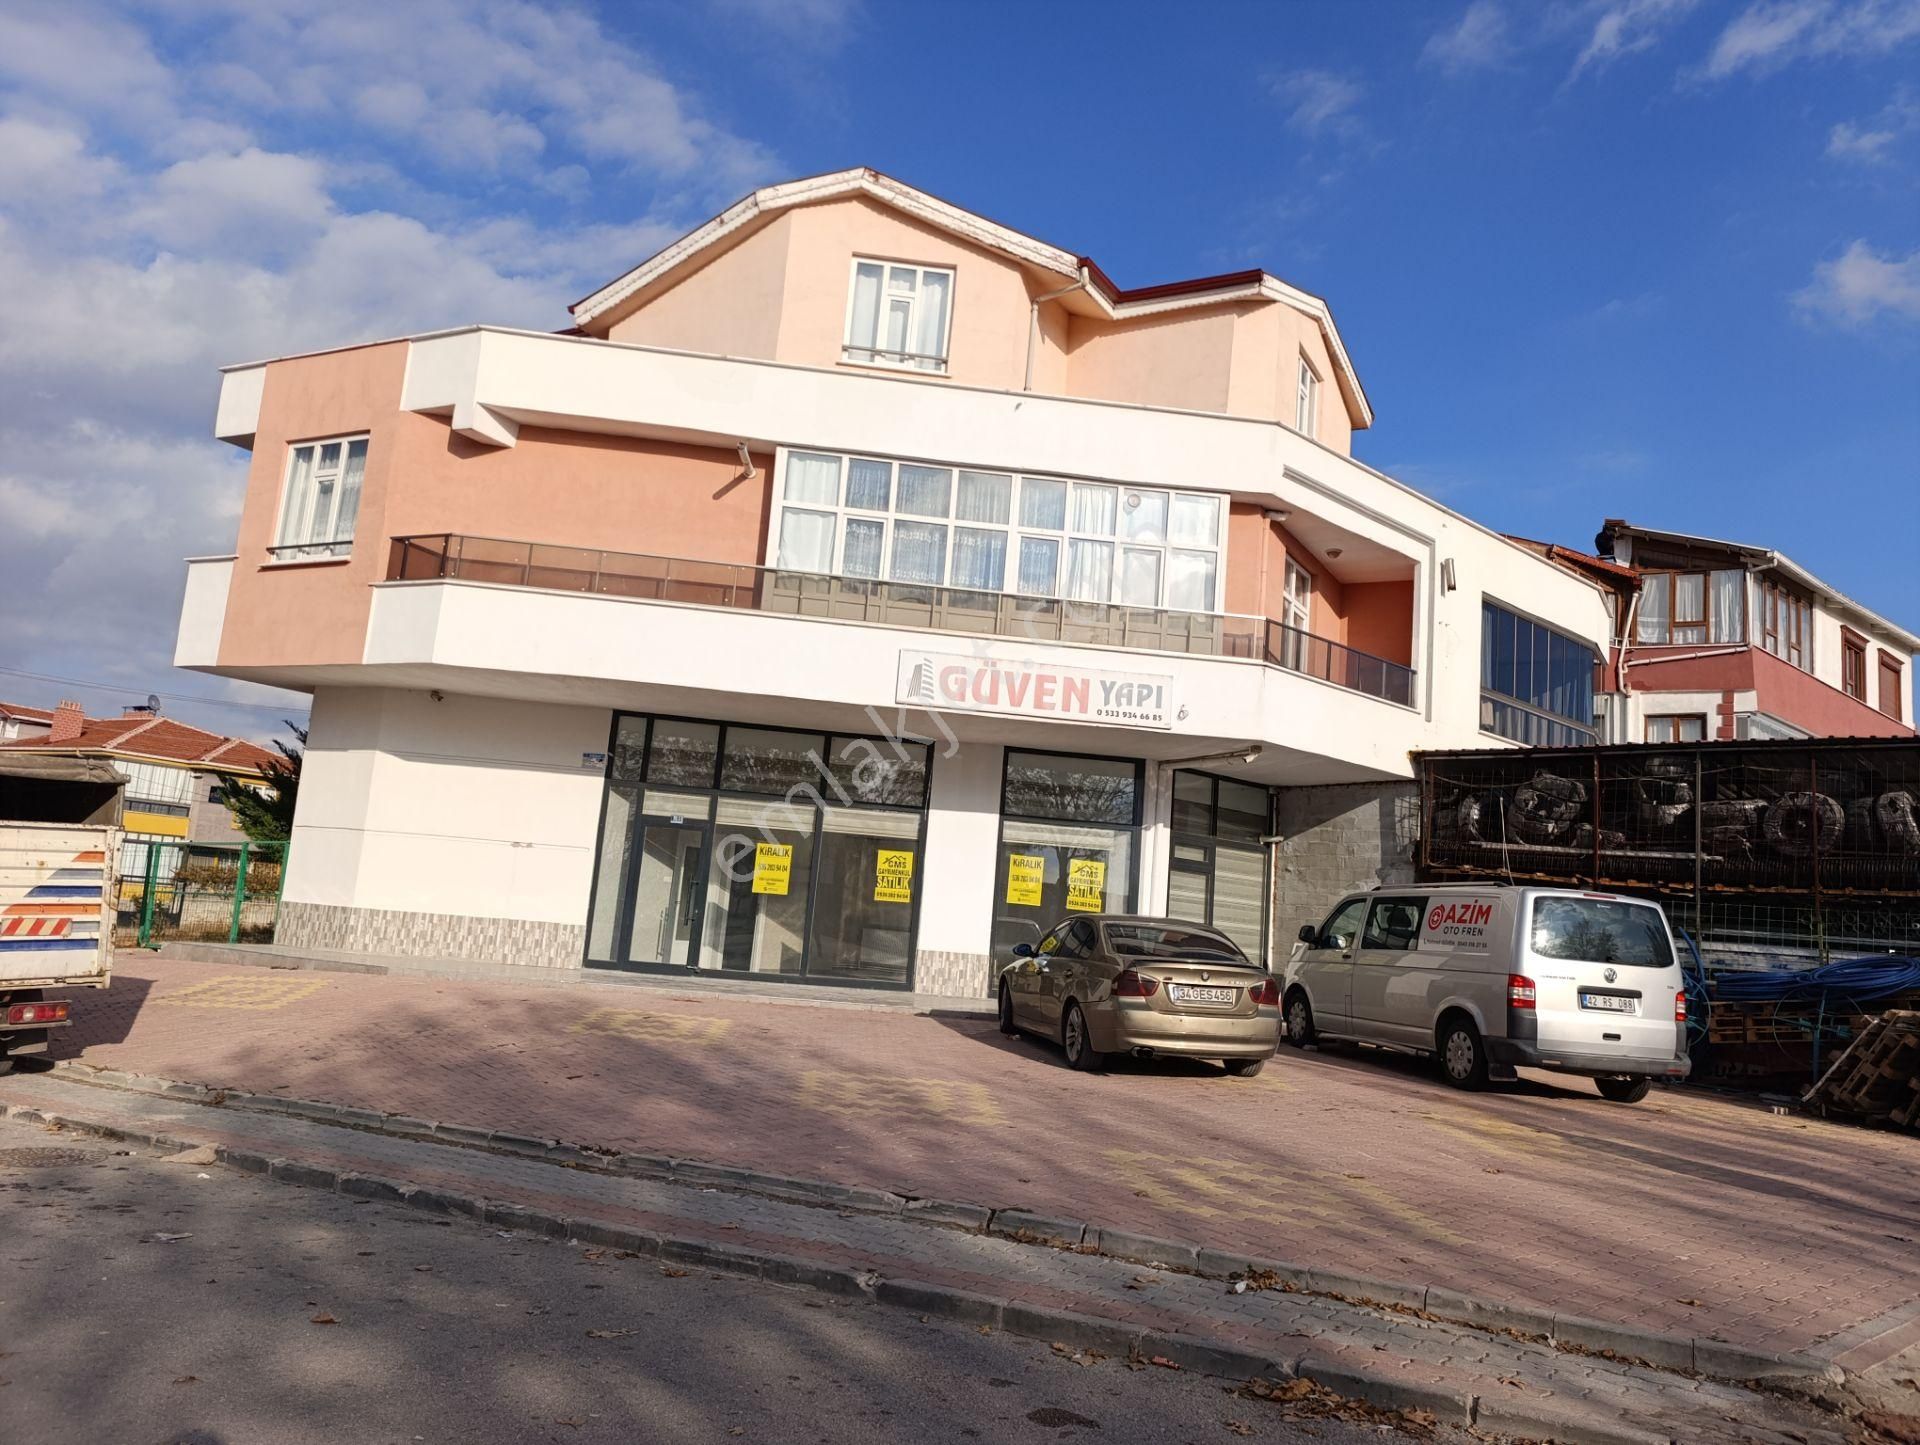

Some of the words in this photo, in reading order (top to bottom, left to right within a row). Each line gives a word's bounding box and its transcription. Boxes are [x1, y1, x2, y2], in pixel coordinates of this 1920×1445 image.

[939, 660, 1090, 714] GÜVEN
[1099, 679, 1163, 709] YAPI
[1105, 710, 1120, 718] 533
[1122, 711, 1138, 719] 934
[1140, 712, 1150, 721] 66
[1152, 713, 1163, 722] 85
[1444, 899, 1492, 925] AZİM
[1443, 926, 1460, 935] OTO
[1461, 927, 1484, 937] FREN
[1588, 996, 1597, 1006] 42
[1603, 997, 1612, 1007] RS
